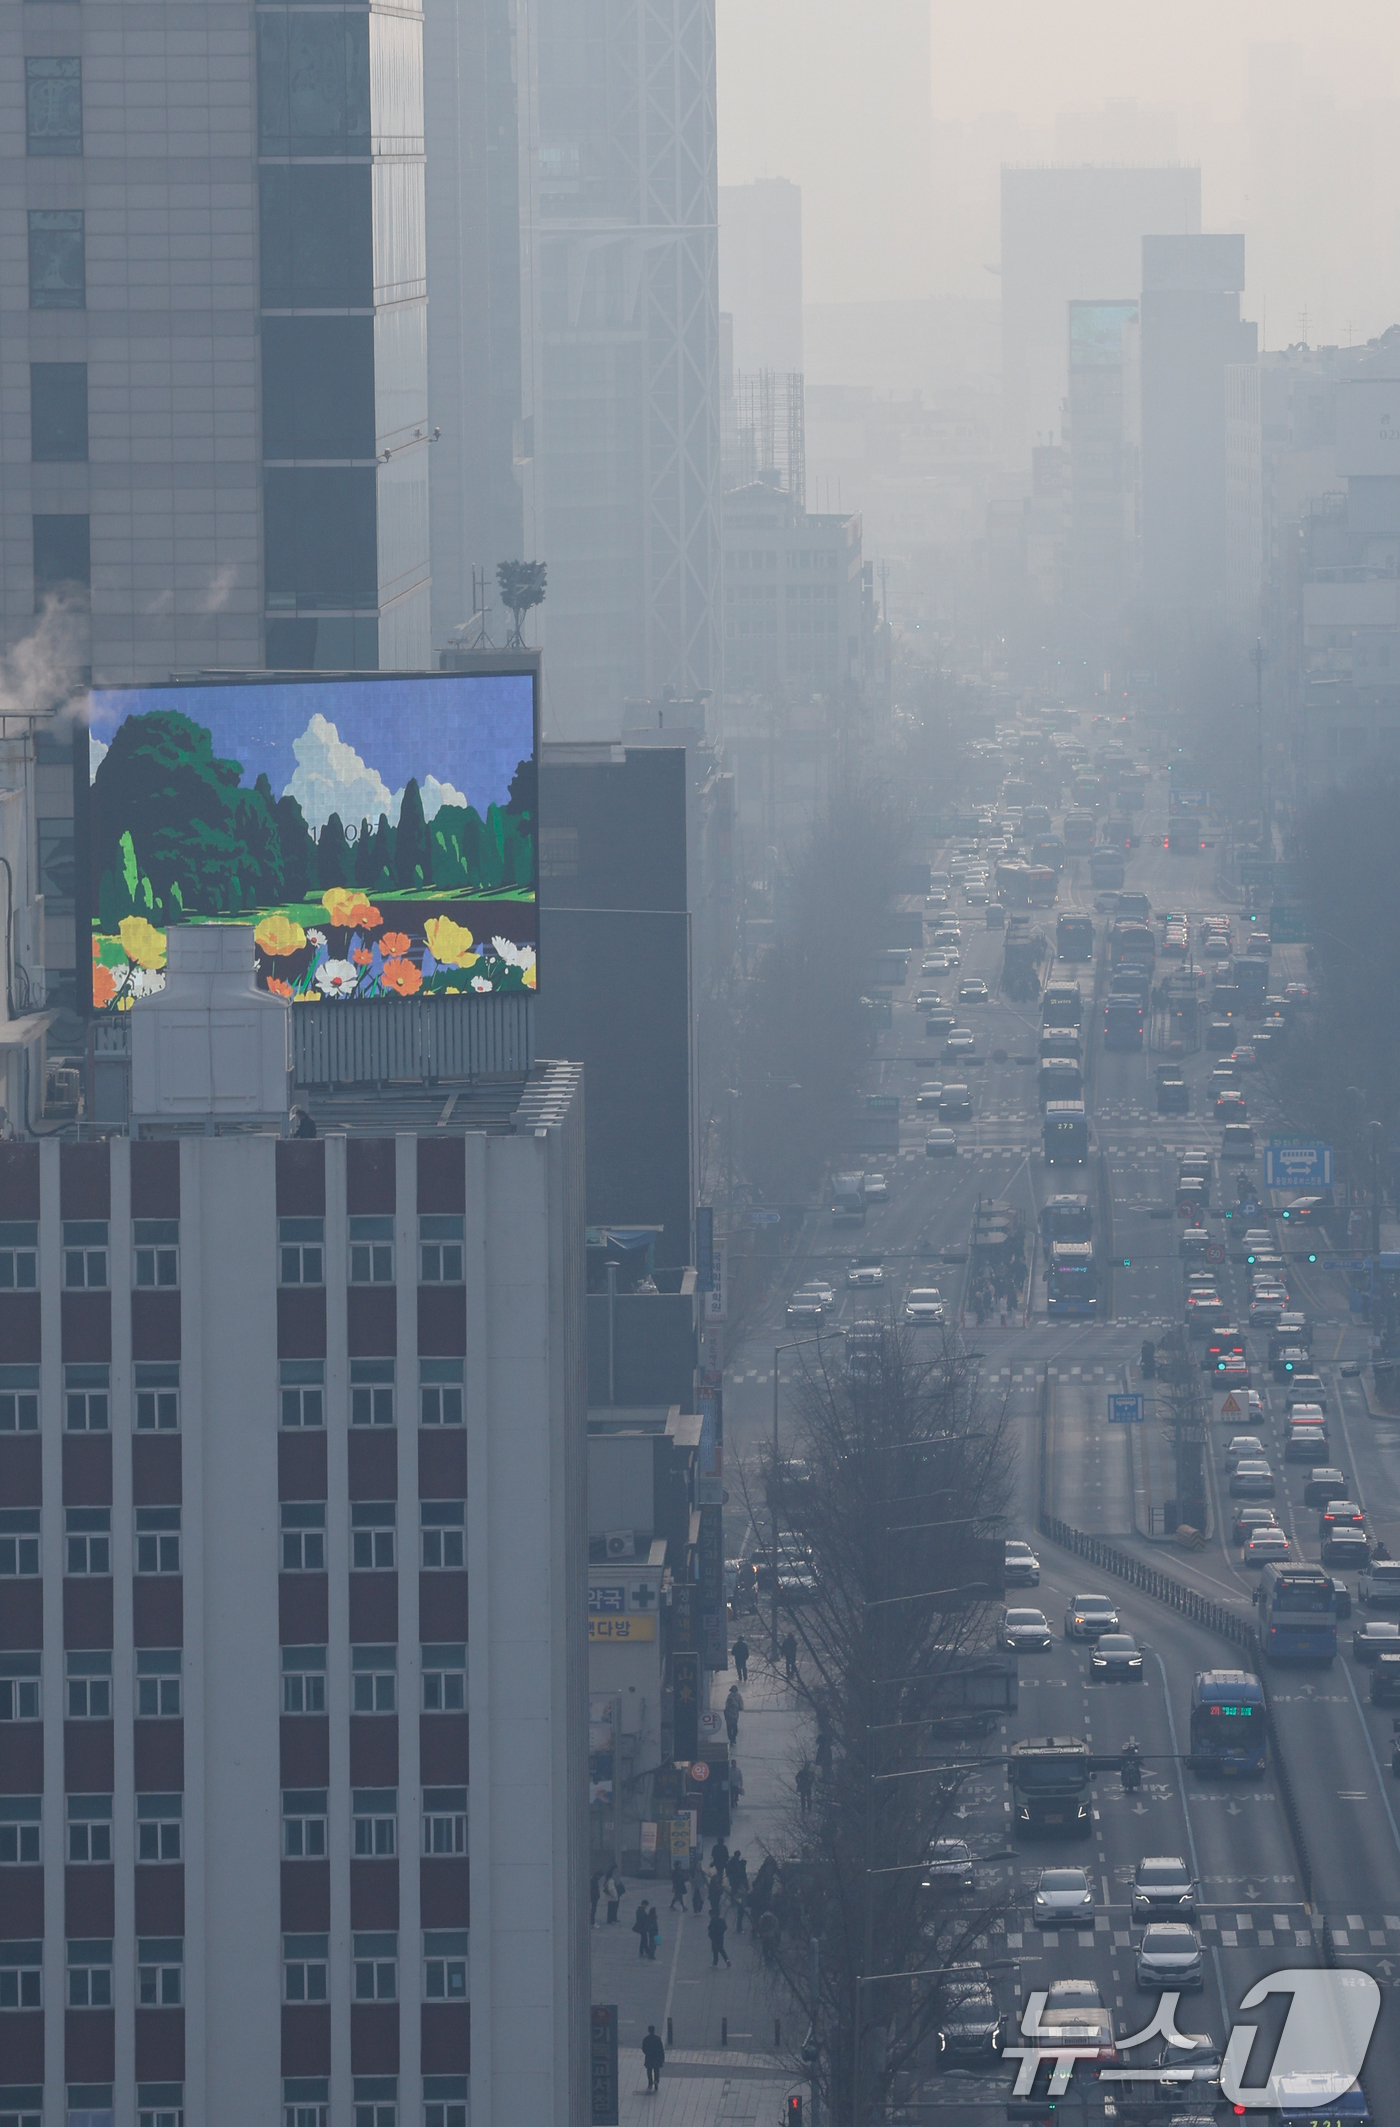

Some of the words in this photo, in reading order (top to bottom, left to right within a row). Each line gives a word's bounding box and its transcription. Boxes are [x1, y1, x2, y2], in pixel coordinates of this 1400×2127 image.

[1275, 1176, 1322, 1186] 중앙차로버스전용
[1210, 1249, 1221, 1259] 50
[588, 1590, 622, 1610] 약국
[702, 1714, 718, 1729] 약
[694, 1765, 706, 1778] 약
